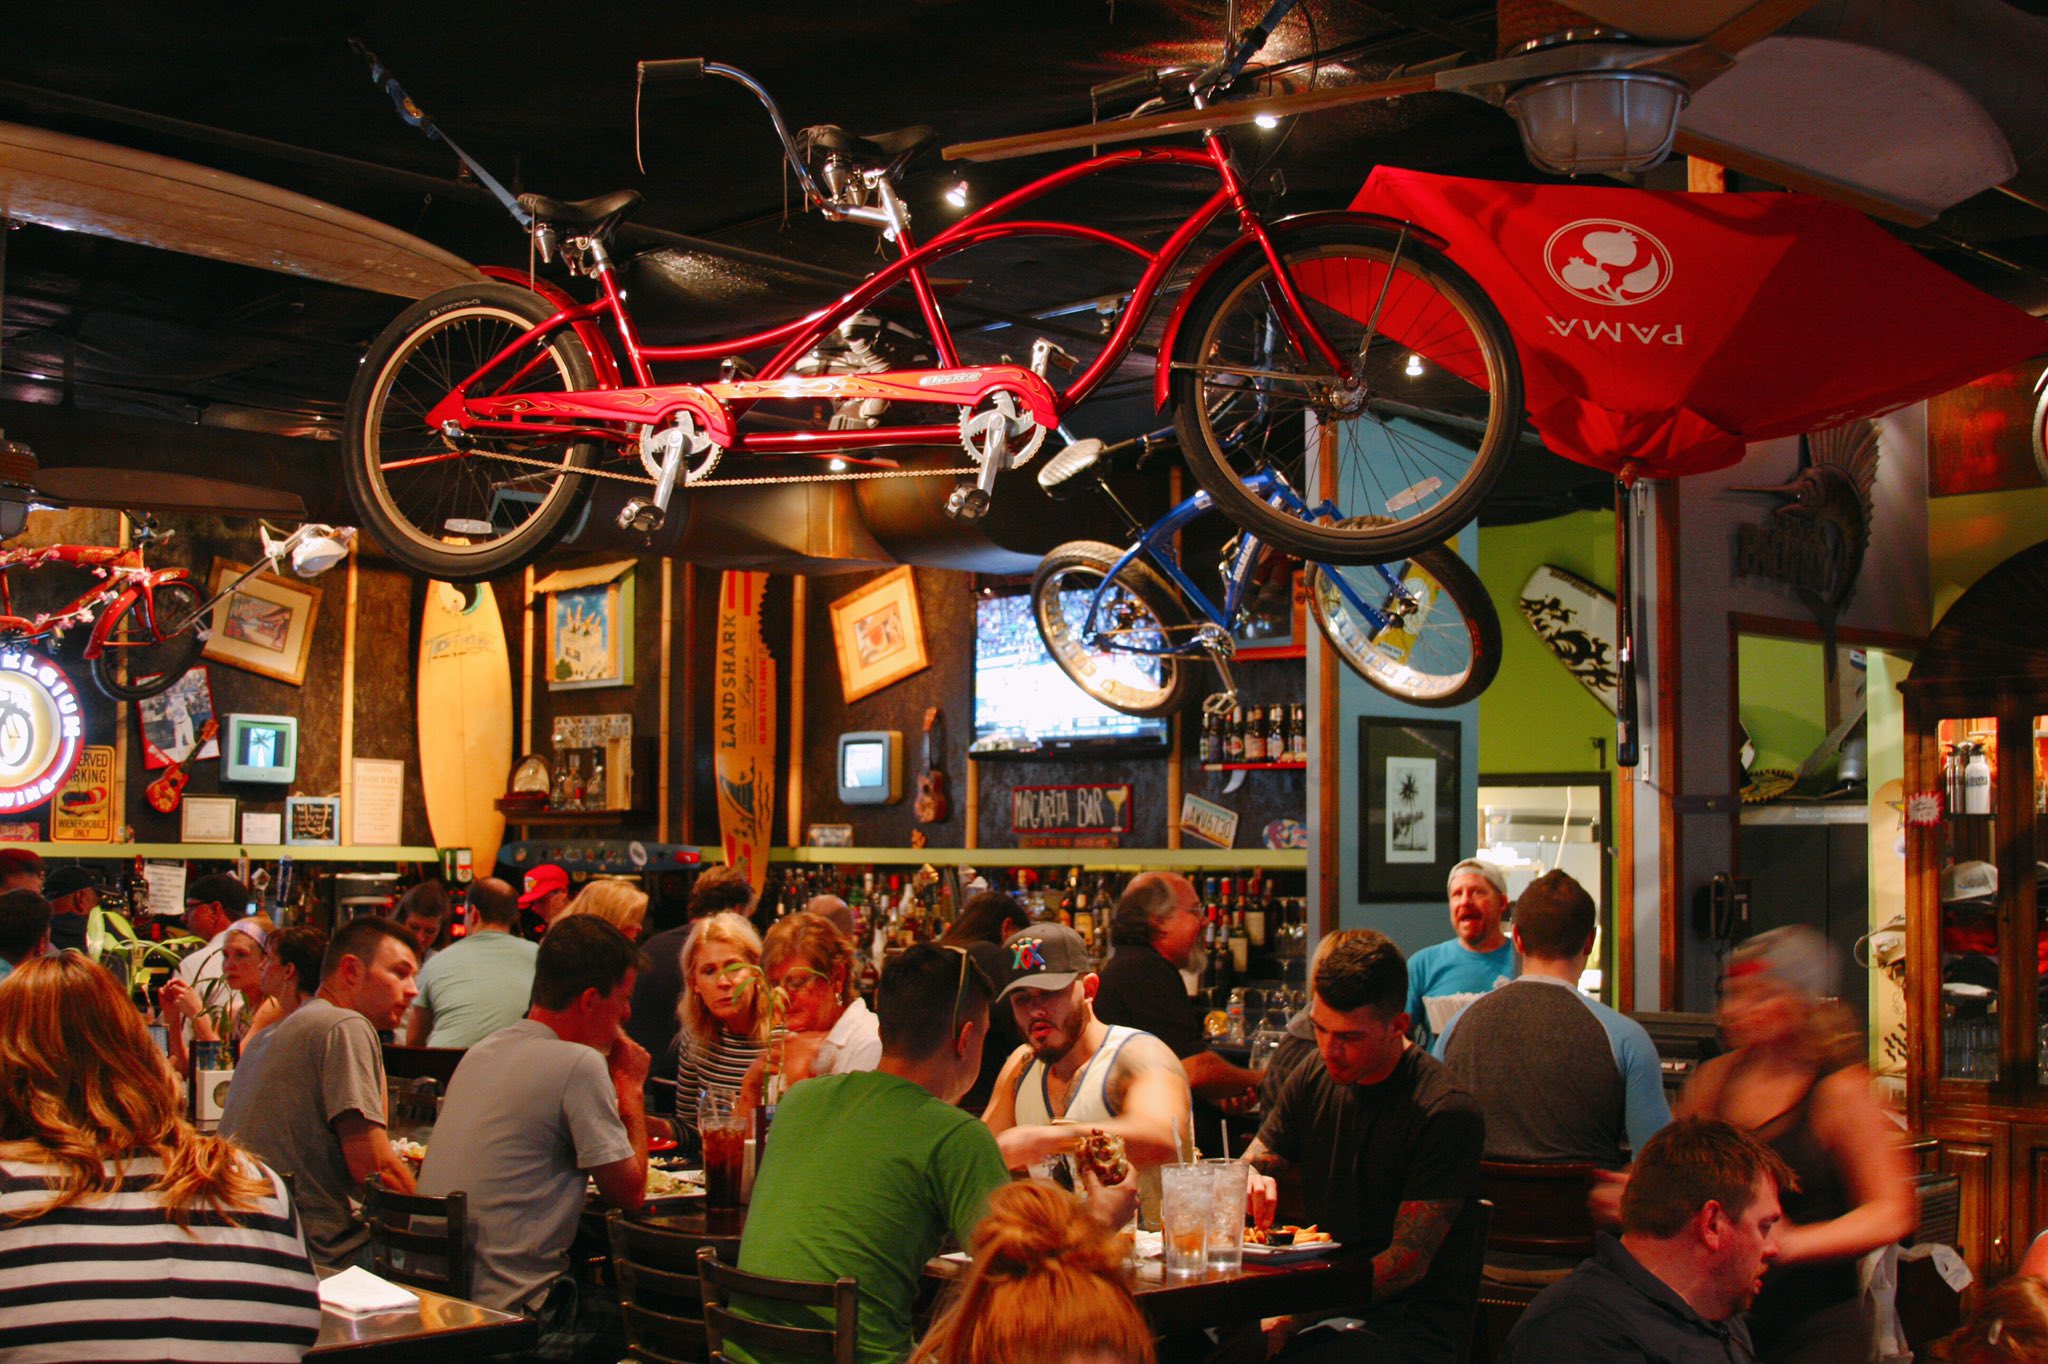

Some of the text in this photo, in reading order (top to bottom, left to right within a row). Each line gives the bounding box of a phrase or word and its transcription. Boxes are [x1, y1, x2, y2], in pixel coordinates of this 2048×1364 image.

[1545, 315, 1684, 346] PAMA
[721, 613, 737, 749] LANDSHARK
[0, 652, 82, 738] ELGIUM
[78, 752, 109, 768] ERVED
[70, 769, 106, 783] RKING
[1015, 787, 1104, 829] MARGARITA BAR
[57, 818, 106, 828] WIENERMOBILE
[73, 828, 90, 837] ONLY
